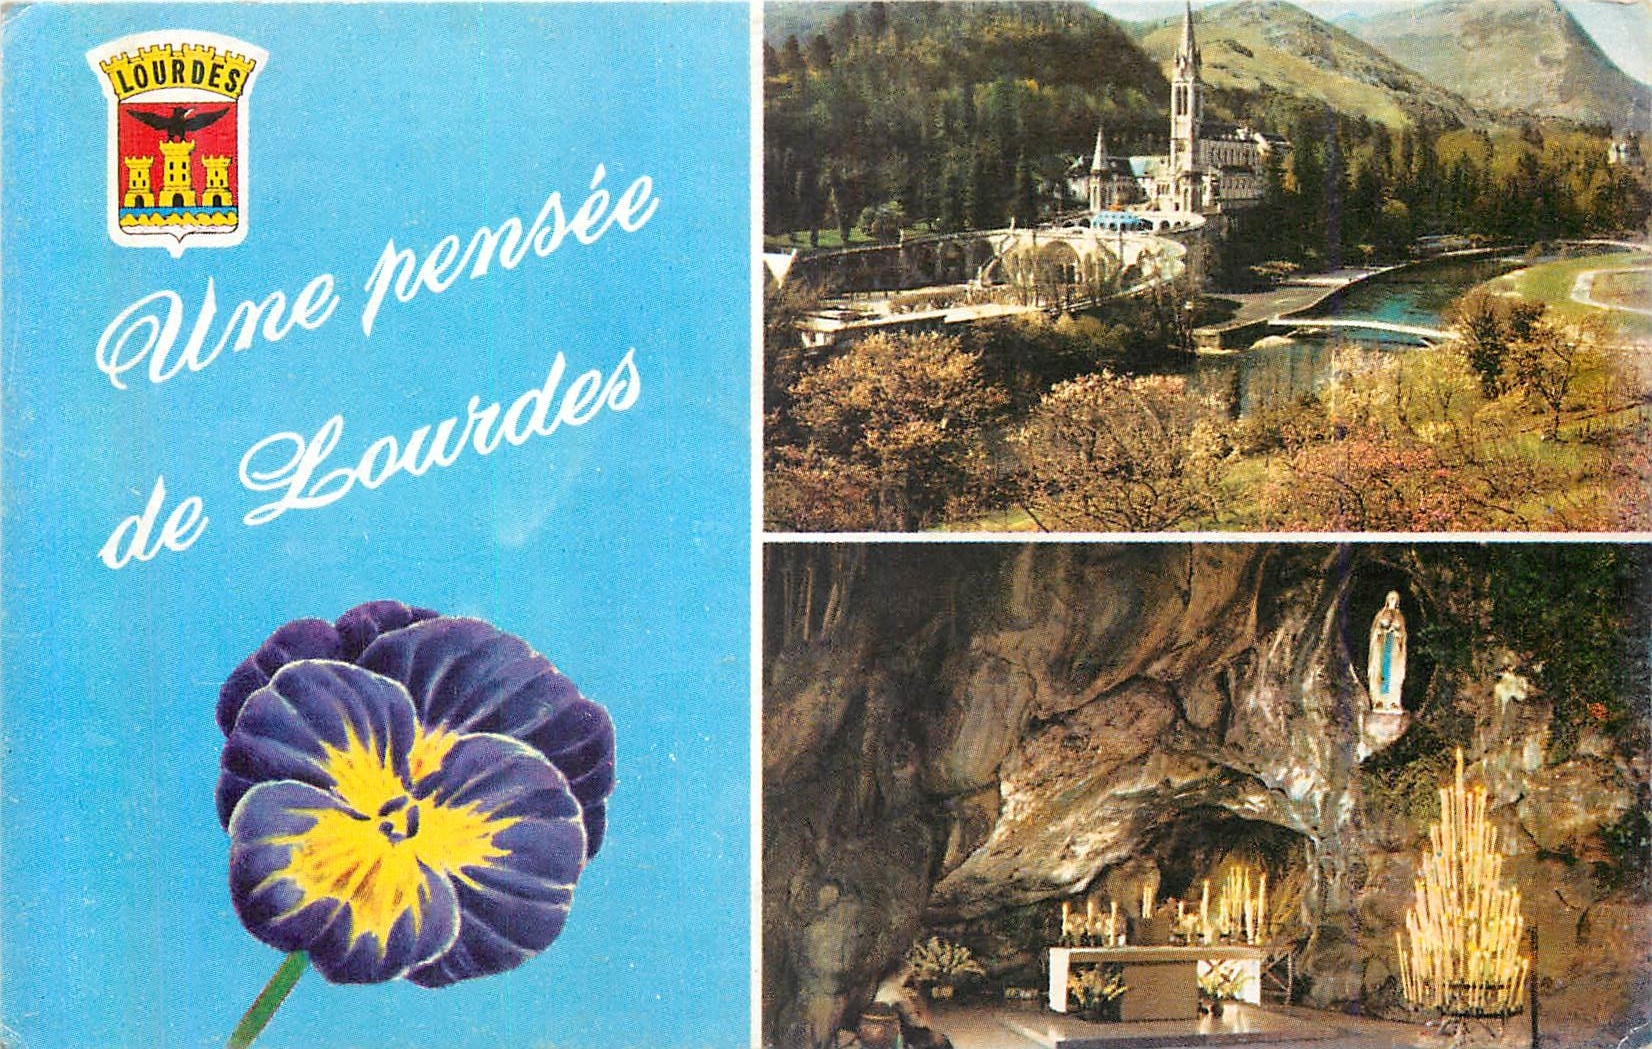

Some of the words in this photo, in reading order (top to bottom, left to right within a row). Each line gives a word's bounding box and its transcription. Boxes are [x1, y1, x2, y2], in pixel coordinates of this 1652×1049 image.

[115, 58, 241, 95] LOURDES
[95, 273, 340, 391] Une
[361, 162, 660, 337] pensée
[97, 475, 209, 570] de
[238, 348, 641, 526] Lourdes
